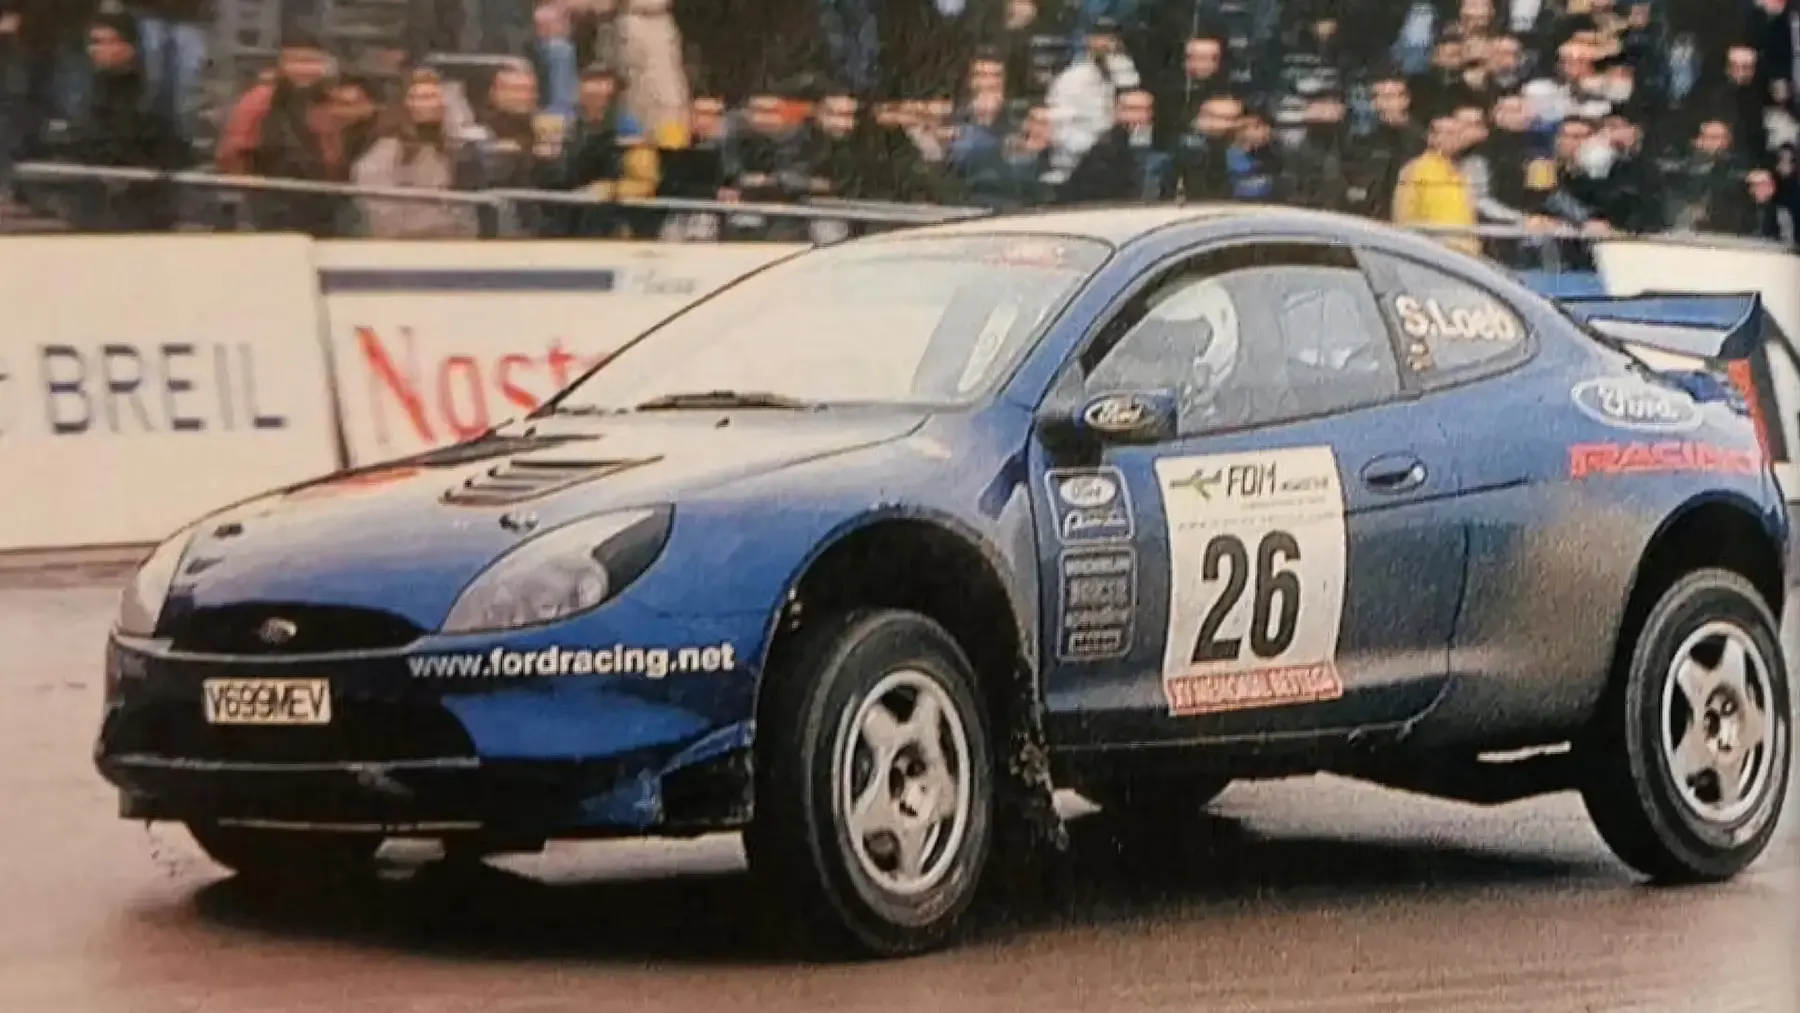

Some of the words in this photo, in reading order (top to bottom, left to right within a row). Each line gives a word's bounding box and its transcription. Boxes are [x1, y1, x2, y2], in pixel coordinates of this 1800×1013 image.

[38, 343, 288, 434] BREIL
[1192, 530, 1302, 663] 26
[408, 642, 736, 679] www.fordracing.net
[207, 684, 328, 719] V699MEV
